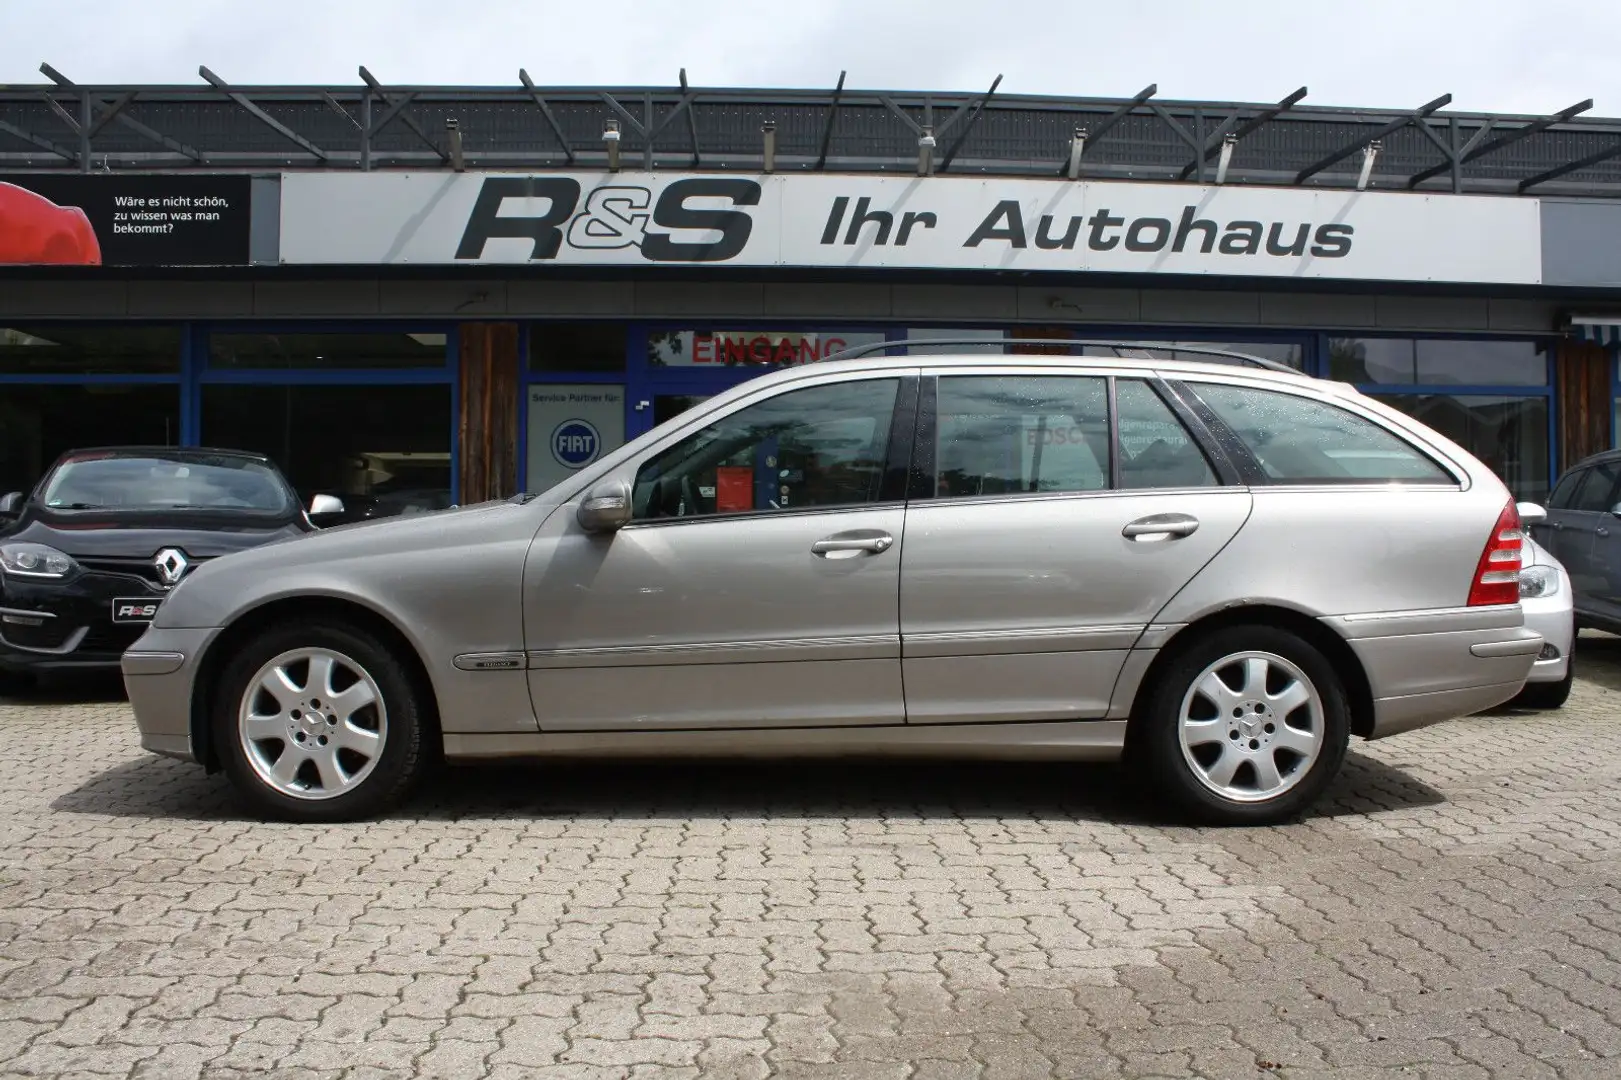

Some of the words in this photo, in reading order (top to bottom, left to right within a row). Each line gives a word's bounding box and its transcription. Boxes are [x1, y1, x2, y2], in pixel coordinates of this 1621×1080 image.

[115, 196, 145, 207] Wäre
[148, 199, 160, 207] es
[163, 196, 191, 207] nicht
[194, 196, 229, 208] schön,
[114, 212, 128, 221] zu
[131, 210, 167, 221] wissen
[170, 212, 192, 221] was
[195, 212, 220, 221] man
[454, 177, 762, 262] R&S
[820, 196, 938, 246] Ihr
[962, 199, 1354, 258] Autohaus
[113, 223, 174, 234] bekommt?
[532, 393, 566, 402] Service
[569, 393, 602, 402] Partner
[558, 435, 593, 453] FIAT
